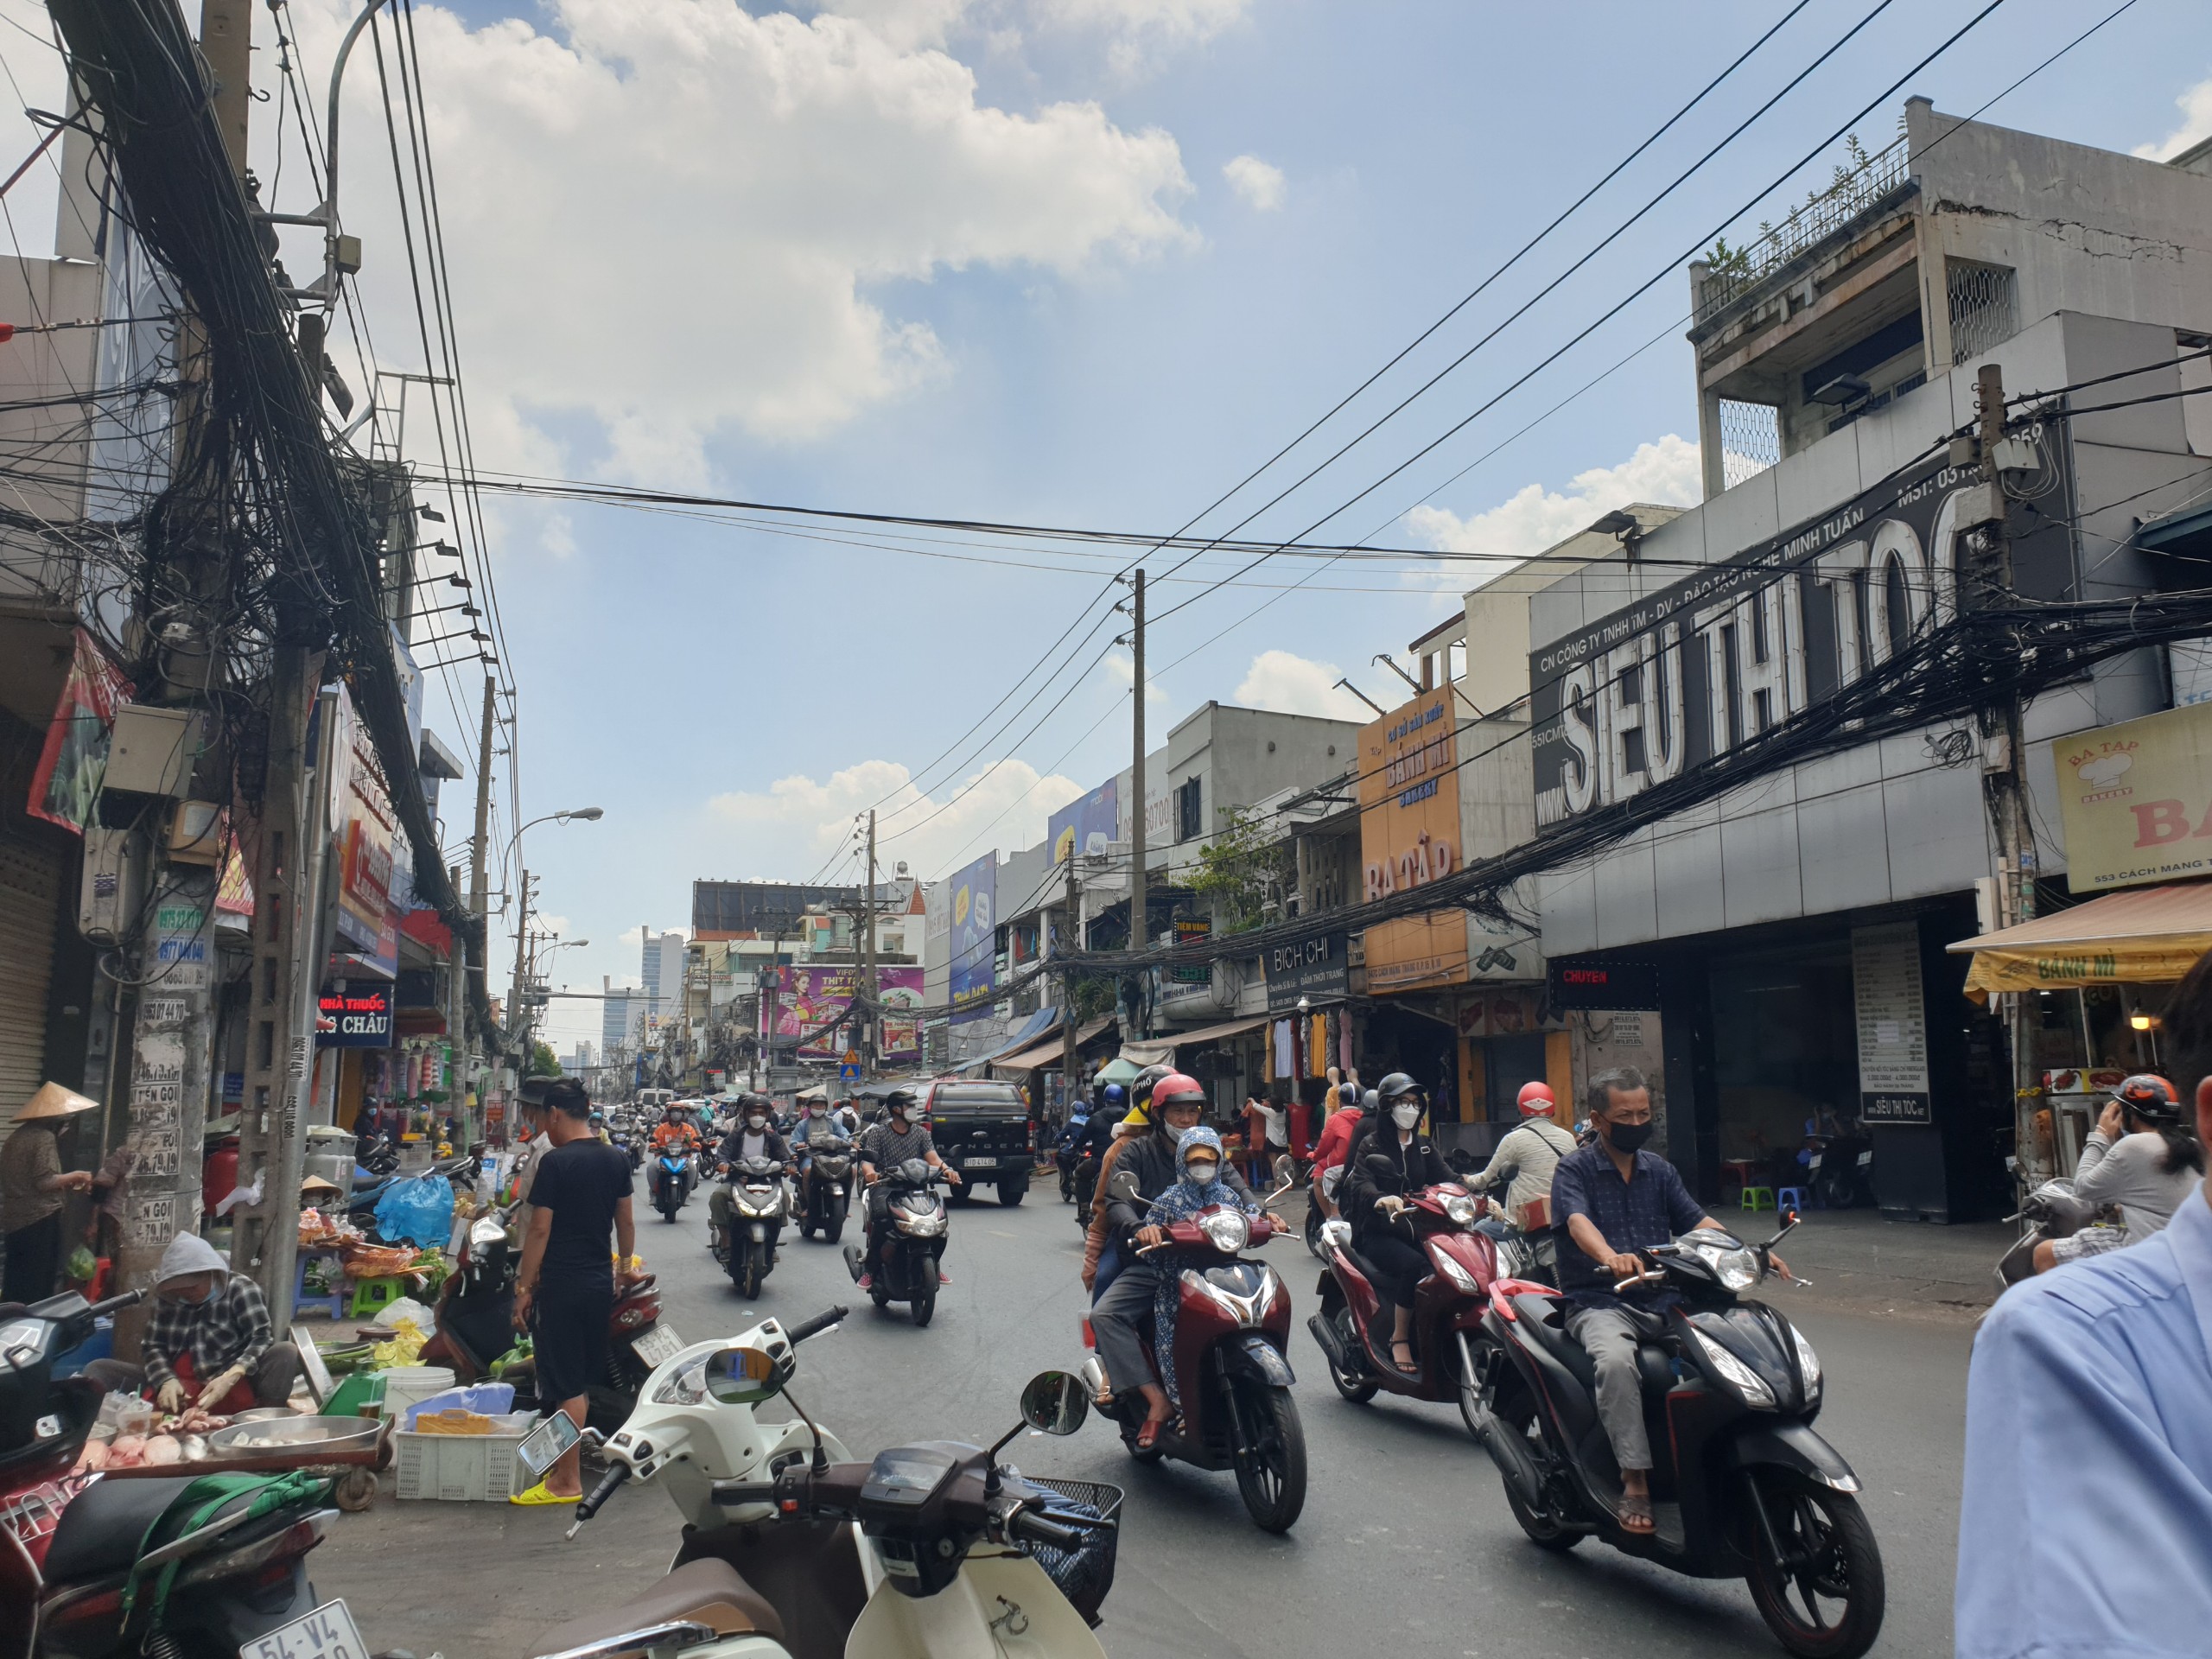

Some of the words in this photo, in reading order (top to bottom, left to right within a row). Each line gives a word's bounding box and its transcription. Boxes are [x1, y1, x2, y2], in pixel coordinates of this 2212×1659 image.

[1541, 655, 1555, 672] CN
[1557, 639, 1586, 665] CÔNG
[1589, 632, 1600, 651] TY
[1603, 618, 1629, 644] TNHH
[1656, 598, 1673, 620] DV
[1784, 529, 1821, 562] MINH
[2082, 787, 2133, 804] BAKERY
[2094, 874, 2115, 883] 553
[2038, 951, 2087, 980] BÁNH
[320, 995, 344, 1010] NHÀ
[346, 992, 386, 1011] THUỐC
[342, 1011, 388, 1034] CHÂU
[936, 1142, 1023, 1151] ANGER
